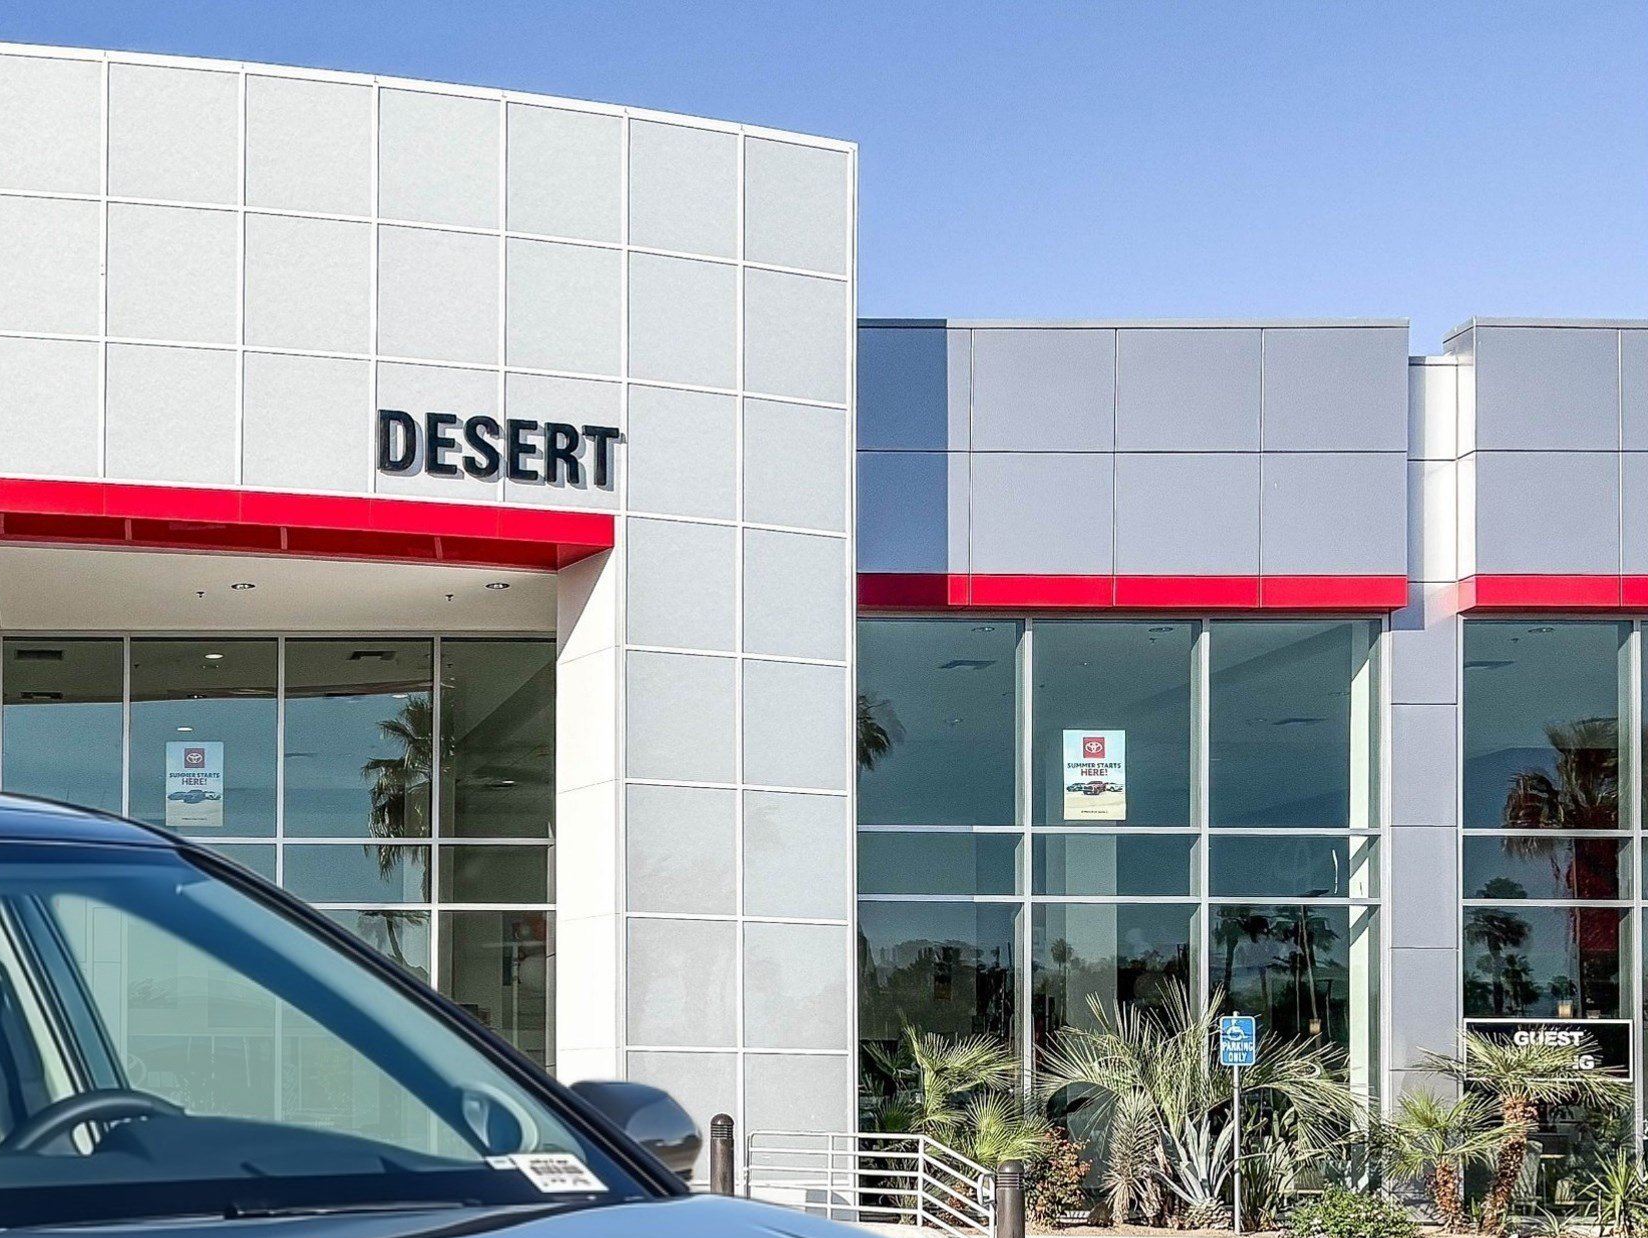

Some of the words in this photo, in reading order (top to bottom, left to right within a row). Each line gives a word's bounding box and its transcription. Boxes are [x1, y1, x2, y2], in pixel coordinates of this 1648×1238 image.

[377, 409, 620, 487] DESERT
[182, 778, 207, 786] HERE!
[1513, 1031, 1584, 1046] GUEST
[1222, 1041, 1254, 1051] PARKING
[1228, 1052, 1247, 1062] ONLY
